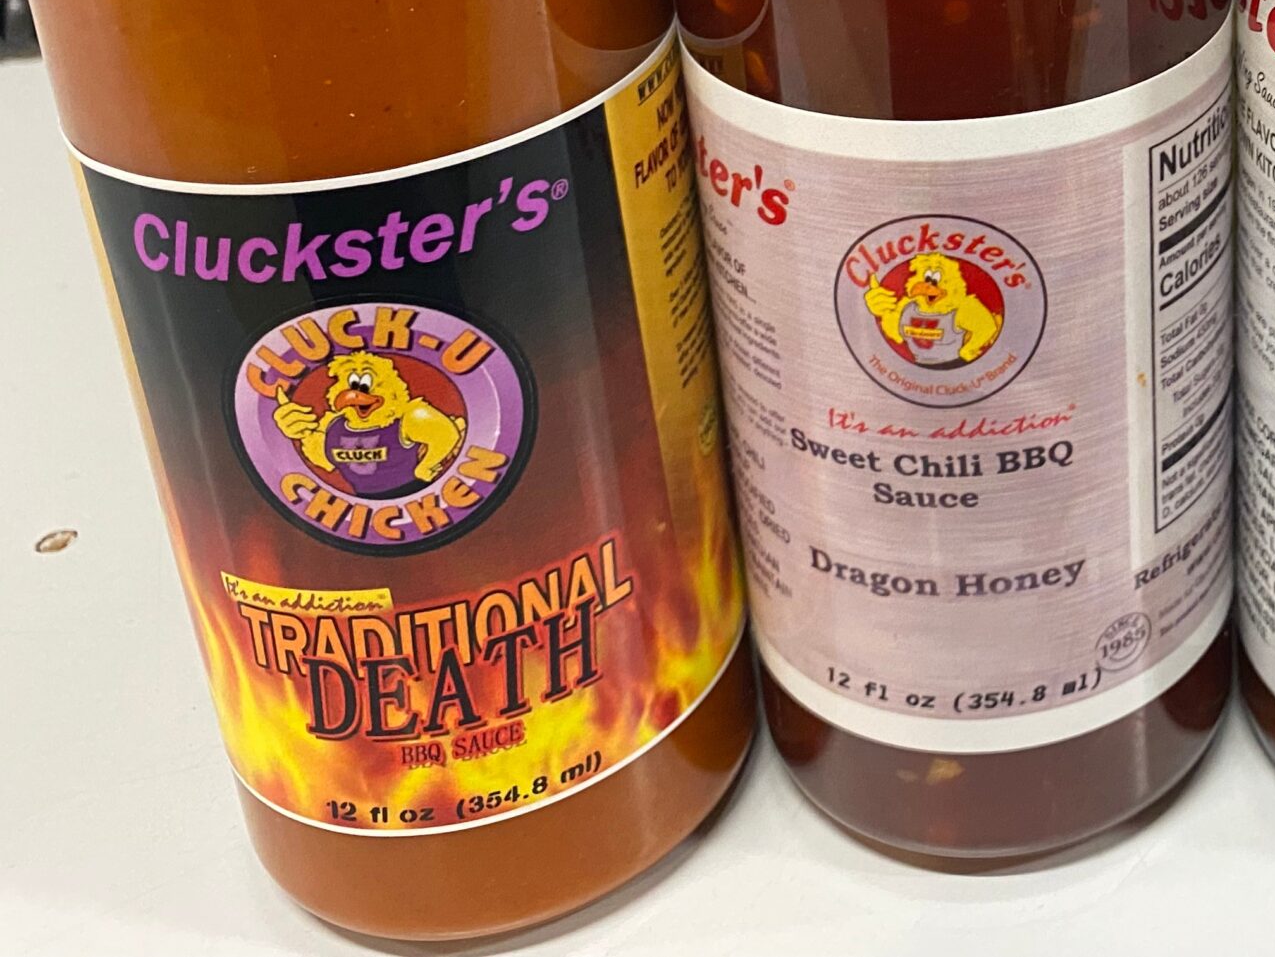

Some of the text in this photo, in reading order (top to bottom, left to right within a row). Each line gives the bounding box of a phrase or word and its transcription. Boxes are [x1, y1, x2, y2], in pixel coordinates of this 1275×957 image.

[634, 137, 669, 188] FLAVOR
[1159, 197, 1201, 231] Serving
[1160, 233, 1222, 298] Calories
[246, 306, 493, 398] CLUCK-U
[868, 354, 888, 376] The
[888, 370, 934, 395] Original
[828, 408, 869, 433] It's
[877, 424, 919, 438] an
[334, 449, 384, 462] CLUCK
[790, 427, 1074, 477] Sweet Chili BBQ
[280, 445, 508, 541] CHICKEN
[872, 482, 979, 509] Sauce
[809, 544, 1087, 597] Dragon Honey
[240, 543, 633, 678] TRADITIONAL
[253, 594, 276, 606] an
[1099, 624, 1146, 659] 1985
[302, 596, 603, 741] DEATH
[826, 666, 1102, 713] 12 fl oz (354.8 ml)
[401, 721, 526, 767] BBQ SAUCE
[326, 750, 602, 824] 12 fl oz (354.8 ml)
